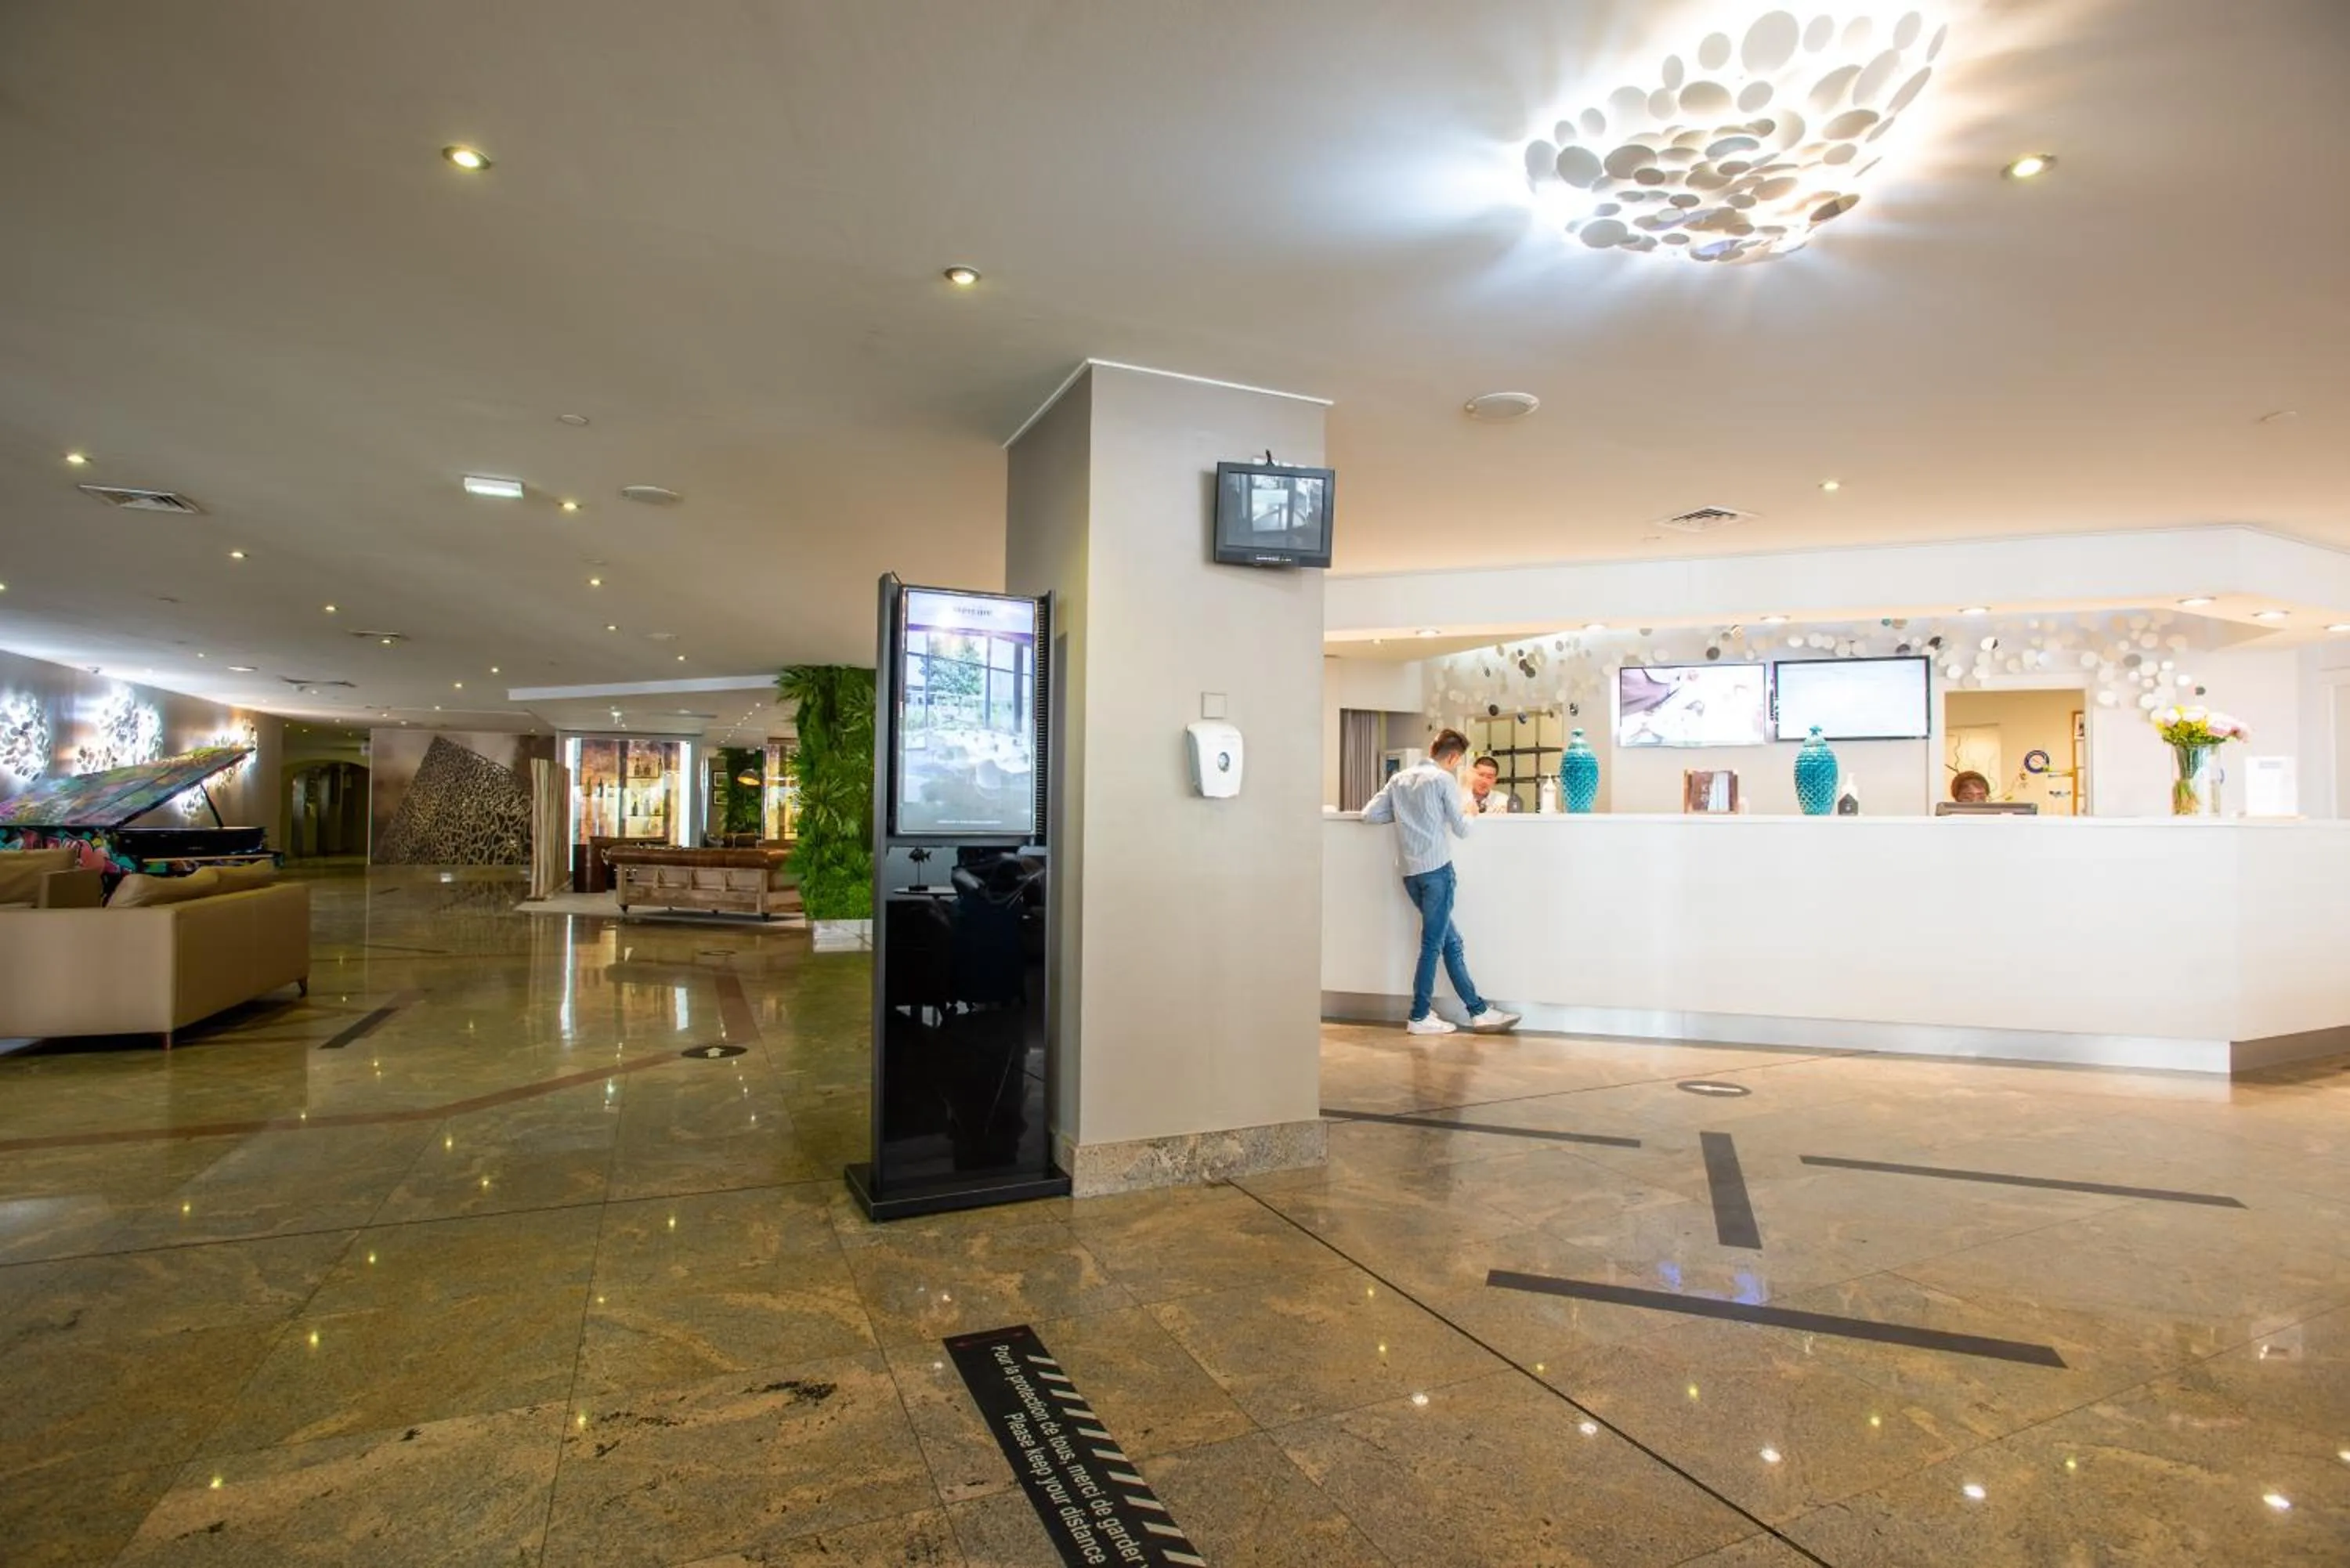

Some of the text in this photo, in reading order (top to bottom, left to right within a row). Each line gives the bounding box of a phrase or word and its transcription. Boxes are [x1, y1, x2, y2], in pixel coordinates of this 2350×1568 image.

[991, 1344, 1145, 1563] Pour la protection de tous, merci de garder
[1003, 1413, 1107, 1565] Please keep your distance
